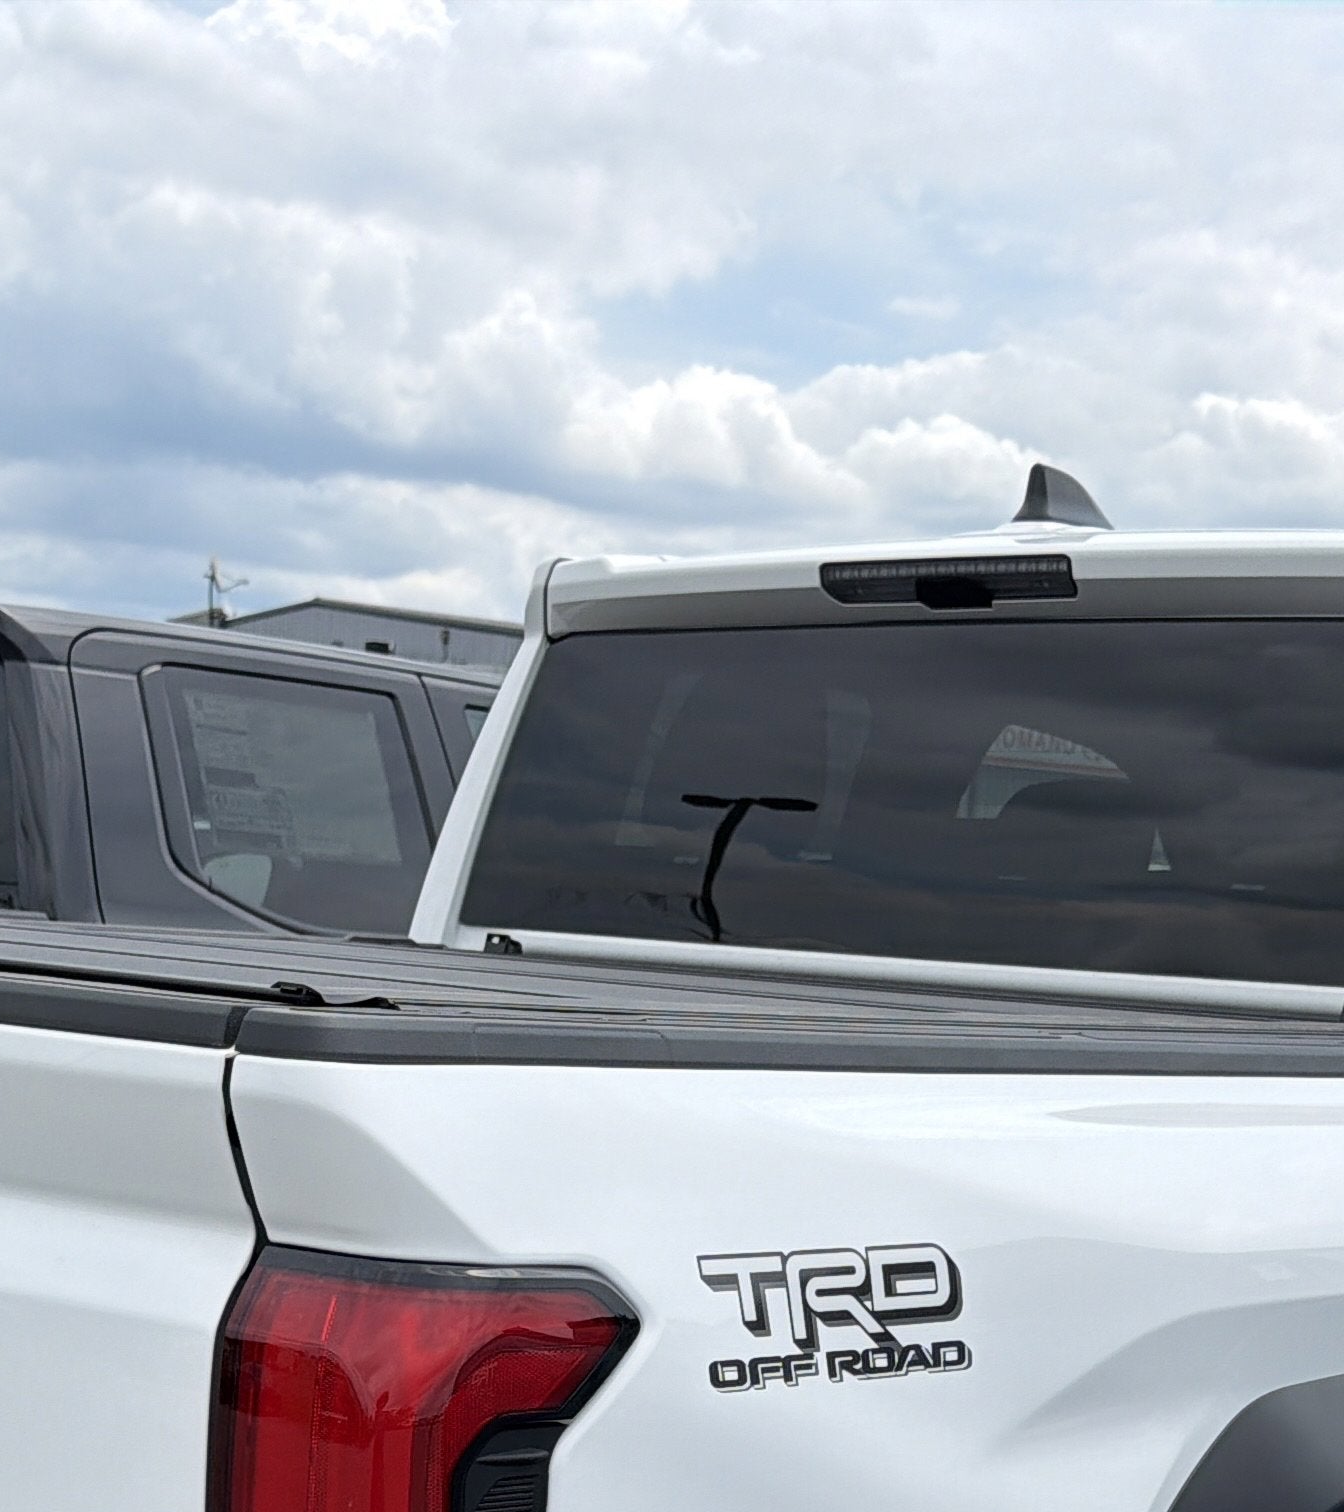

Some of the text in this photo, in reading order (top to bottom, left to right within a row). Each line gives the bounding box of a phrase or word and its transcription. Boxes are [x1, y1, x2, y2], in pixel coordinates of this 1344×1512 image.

[696, 1242, 964, 1353] TRD
[709, 1340, 973, 1393] OFF ROAD
